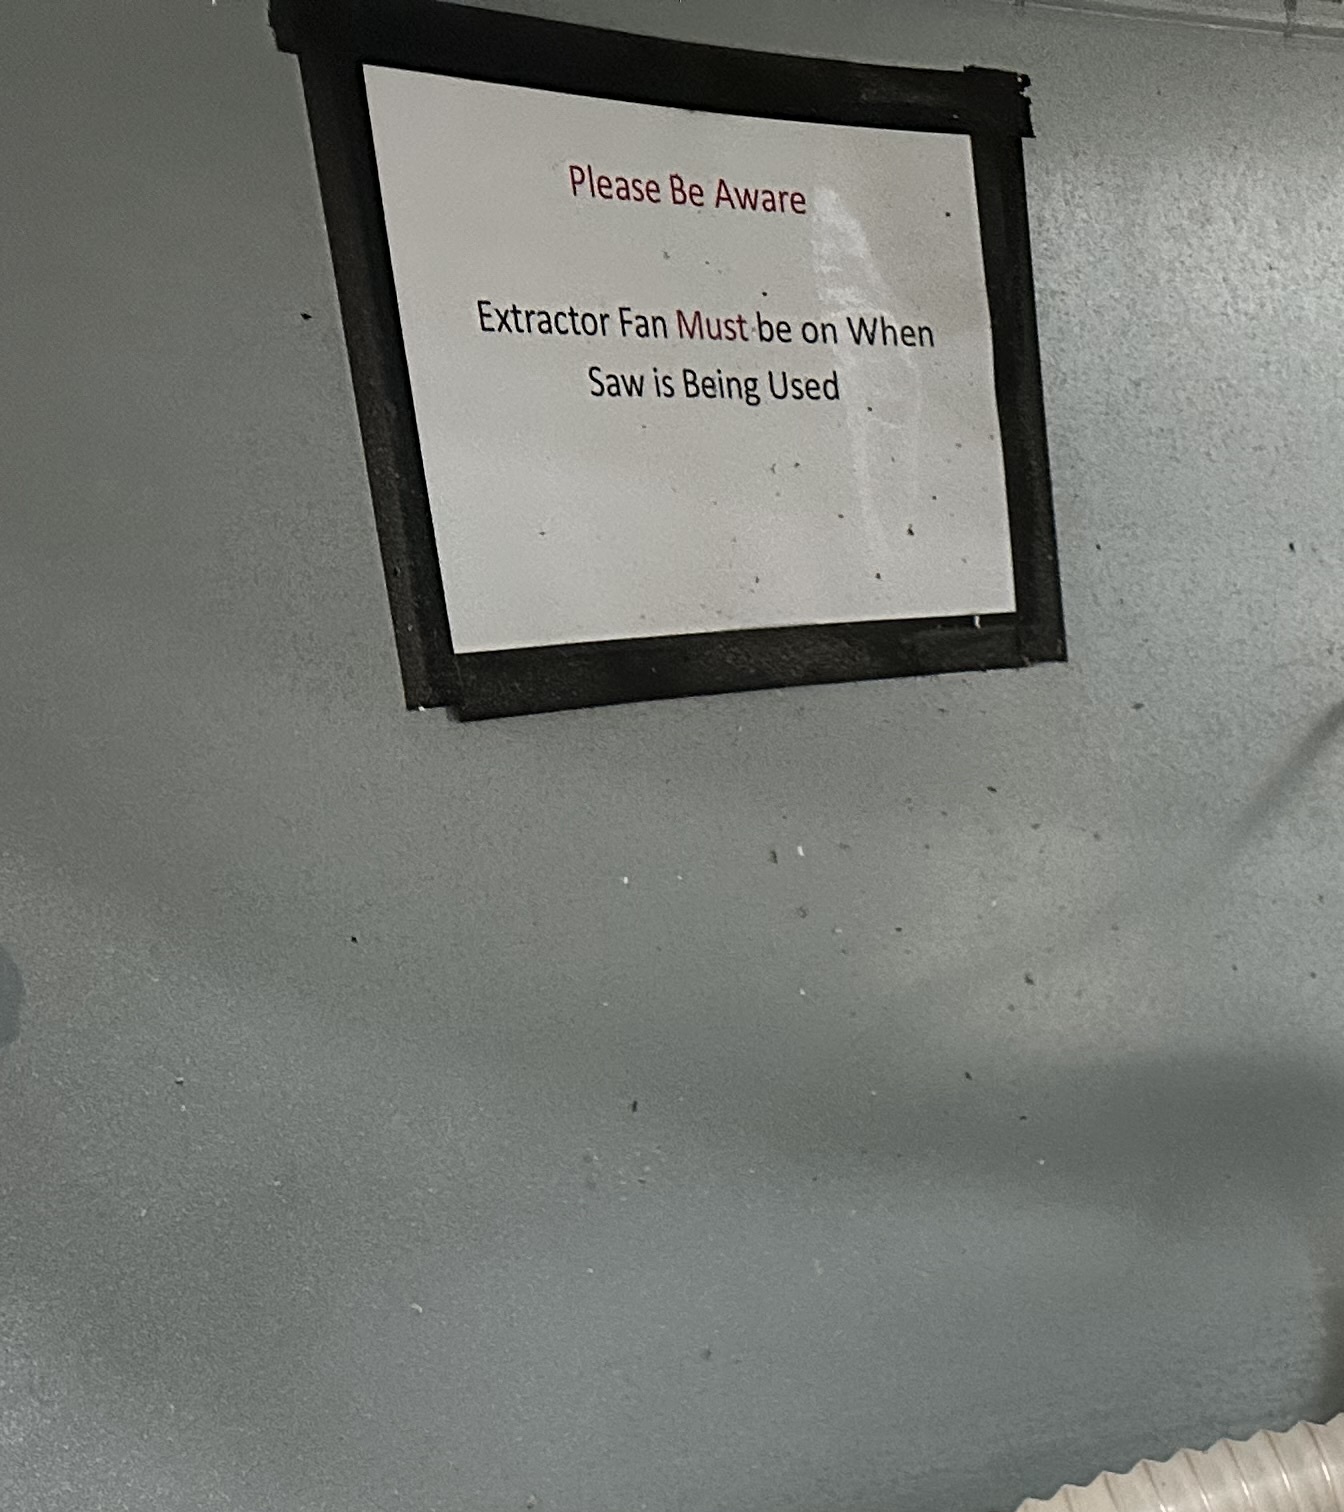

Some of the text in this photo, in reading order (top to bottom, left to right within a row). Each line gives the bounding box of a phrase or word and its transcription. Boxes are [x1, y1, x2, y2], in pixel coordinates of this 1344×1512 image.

[568, 164, 807, 215] Please Be Aware
[477, 300, 935, 348] Extractor Fan Must be on When
[588, 367, 840, 406] Saw is Being Used
